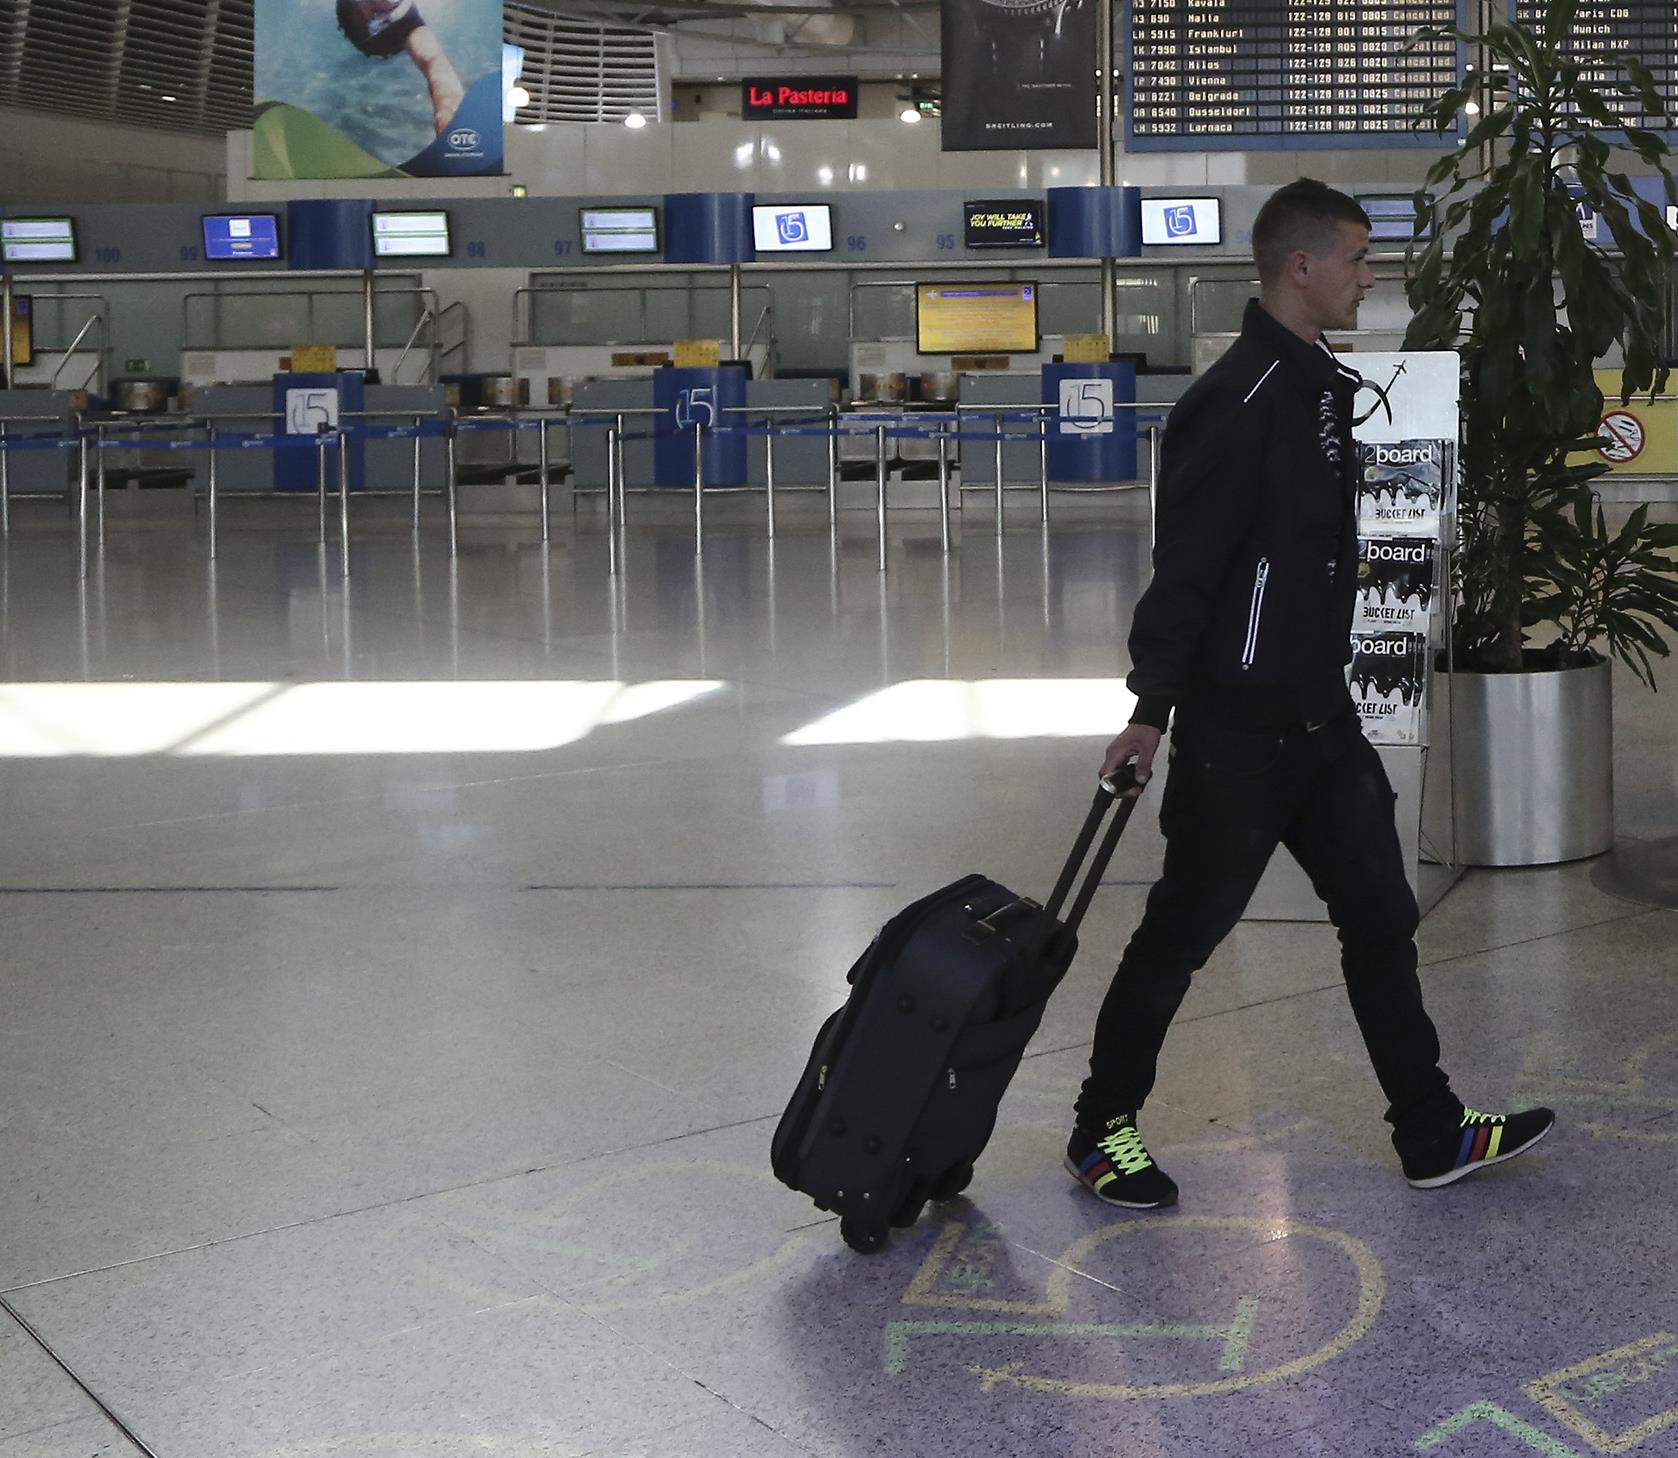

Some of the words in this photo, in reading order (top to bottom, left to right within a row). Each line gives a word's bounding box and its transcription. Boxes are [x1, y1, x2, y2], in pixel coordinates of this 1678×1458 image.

[1150, 14, 1170, 23] 690
[1188, 14, 1220, 23] Malta
[1288, 12, 1331, 21] 122-128
[1132, 30, 1145, 38] LH
[1150, 30, 1176, 38] 5915
[1188, 30, 1244, 38] Frankfurt
[1288, 28, 1331, 36] 122-128
[1573, 24, 1611, 33] Munich
[1132, 45, 1145, 54] TK
[1150, 45, 1176, 54] 7990
[1188, 45, 1238, 54] Istanbul
[1288, 43, 1331, 52] 122-128
[1573, 40, 1604, 48] Milan
[1610, 40, 1629, 48] MXP
[1150, 61, 1176, 70] 7042
[1188, 61, 1220, 70] Milos
[1288, 59, 1331, 68] 122-129
[1151, 76, 1176, 86] 7430
[1188, 76, 1227, 86] Vienna
[1289, 74, 1331, 84] 122-128
[750, 87, 774, 105] La
[1151, 92, 1176, 101] 8221
[1188, 92, 1239, 101] Belgrade
[1289, 90, 1331, 99] 122-128
[1151, 108, 1177, 116] 6540
[1188, 108, 1251, 116] Dusseldorf
[1289, 106, 1331, 114] 122-128
[1133, 123, 1146, 132] LH
[1151, 123, 1177, 132] 5932
[1188, 123, 1233, 132] Larnaca
[1289, 121, 1331, 130] 122-128
[970, 213, 986, 221] JOY
[1007, 212, 1027, 220] TAKE
[970, 220, 987, 228] YOU
[987, 219, 1024, 227] FURTHER
[848, 235, 865, 250] 96
[937, 234, 954, 250] 95
[1364, 445, 1432, 466] 2board
[1407, 509, 1426, 519] LIST
[1363, 606, 1395, 619] BUCKET
[1396, 608, 1416, 620] LIST
[1350, 636, 1407, 655] board
[1379, 703, 1398, 715] LIST
